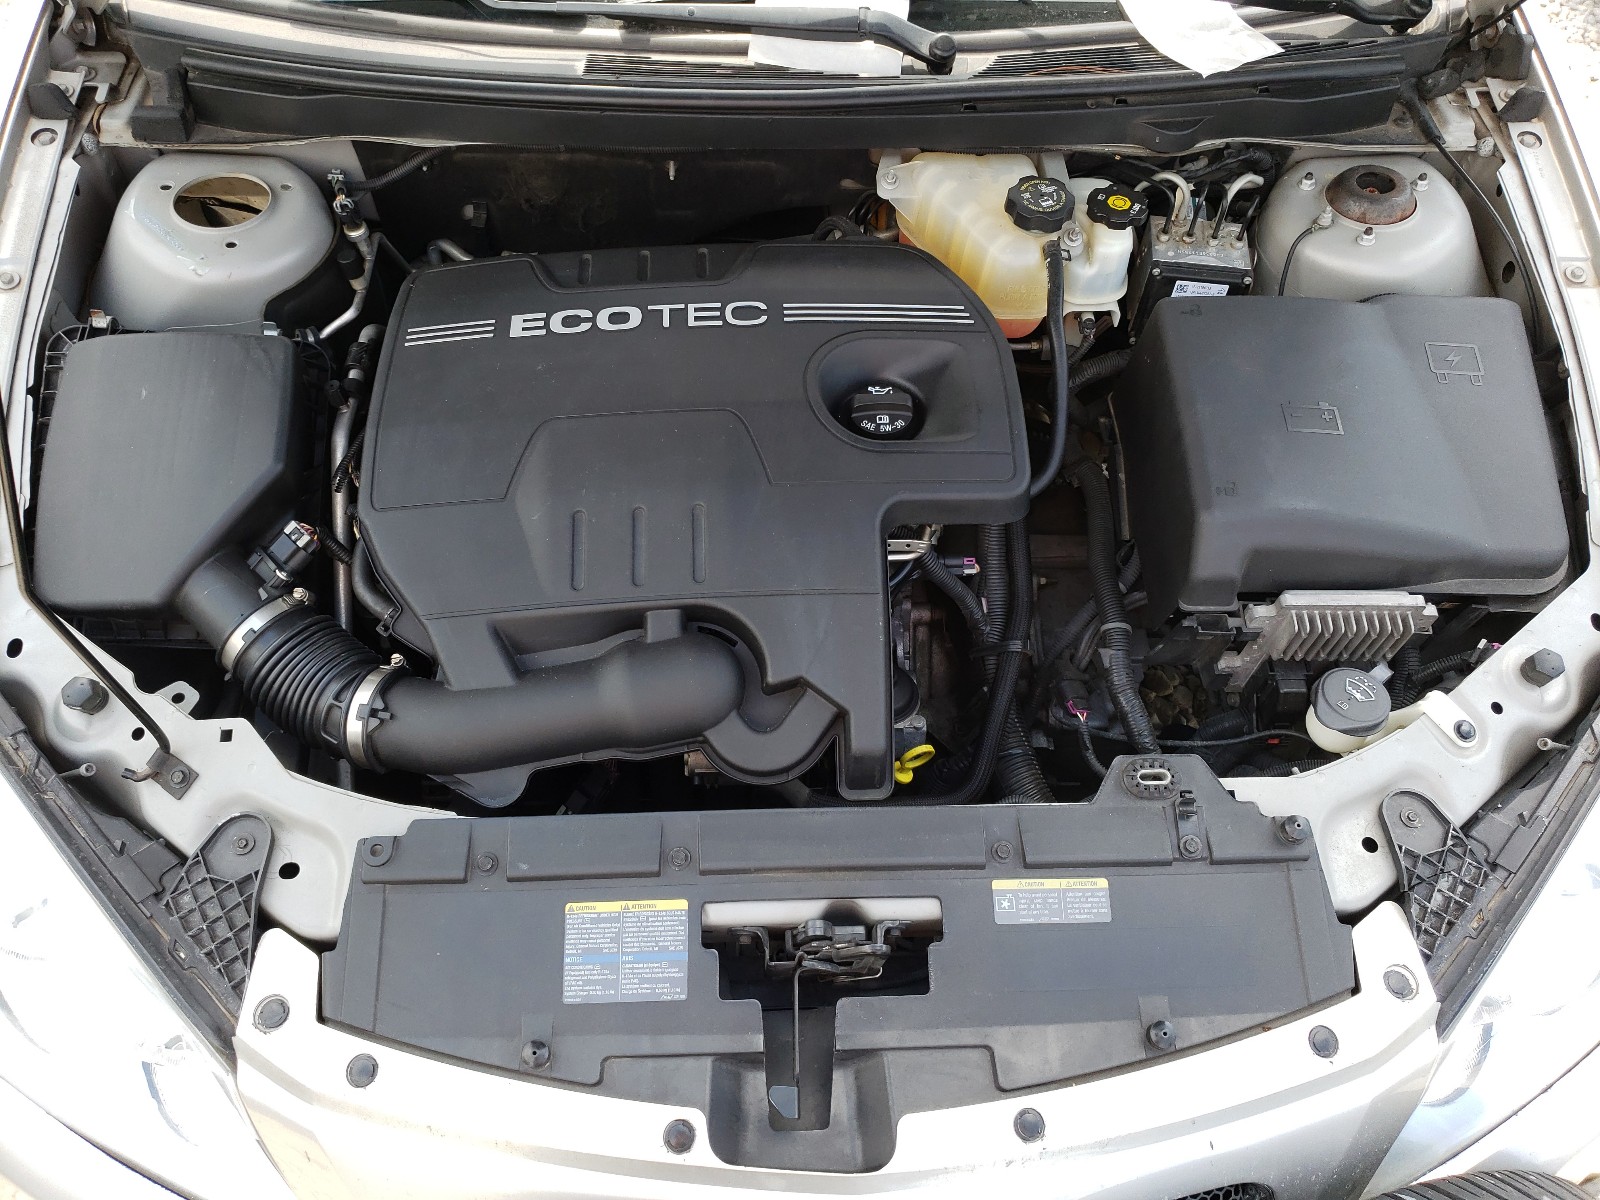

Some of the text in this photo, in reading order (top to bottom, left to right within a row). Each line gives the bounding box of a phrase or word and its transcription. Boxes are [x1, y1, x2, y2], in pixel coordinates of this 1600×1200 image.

[508, 300, 770, 338] ECOTEC
[860, 419, 905, 432] SAE 5W-30
